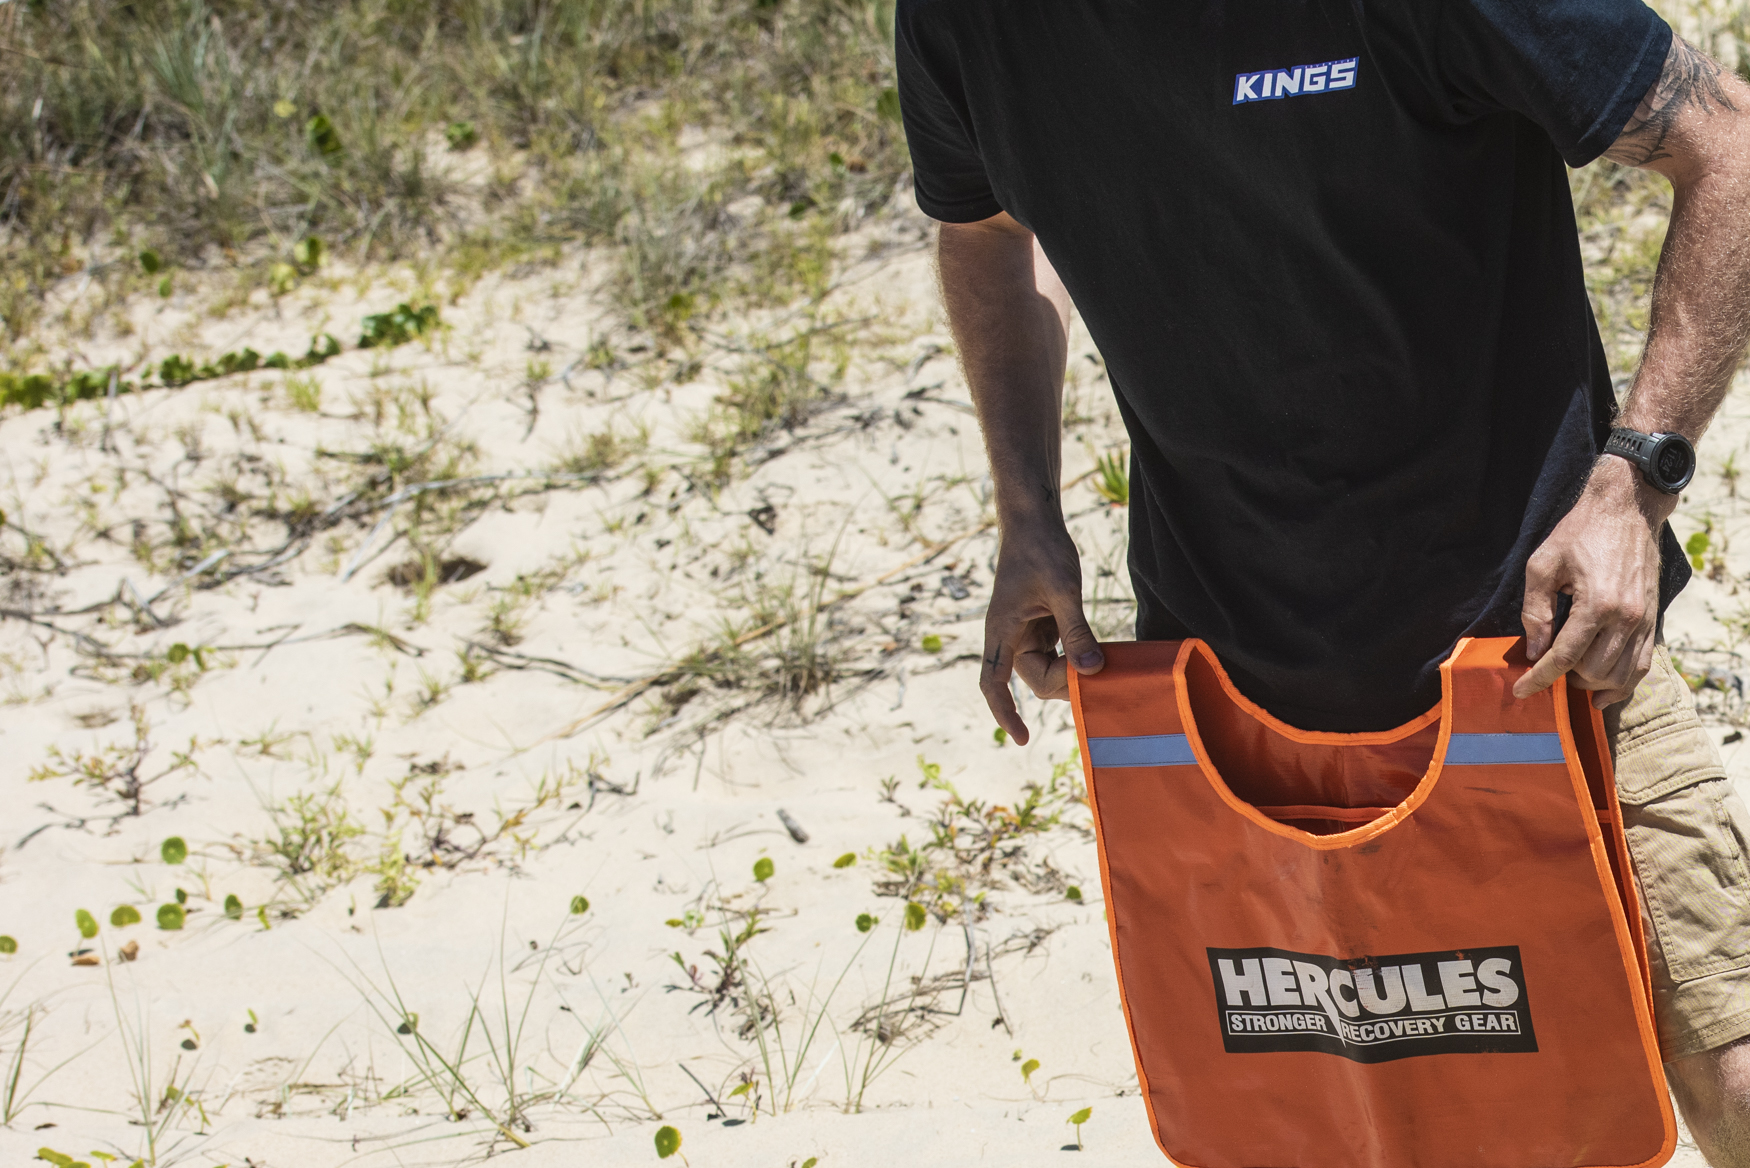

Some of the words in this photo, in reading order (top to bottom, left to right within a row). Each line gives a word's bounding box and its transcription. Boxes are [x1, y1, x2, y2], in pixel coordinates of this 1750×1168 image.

[1236, 61, 1356, 101] KINGS
[1217, 958, 1520, 1030] HERCULES
[1231, 1013, 1328, 1031] STRONGER
[1341, 1017, 1446, 1042] RECOVERY
[1455, 1013, 1517, 1031] GEAR
